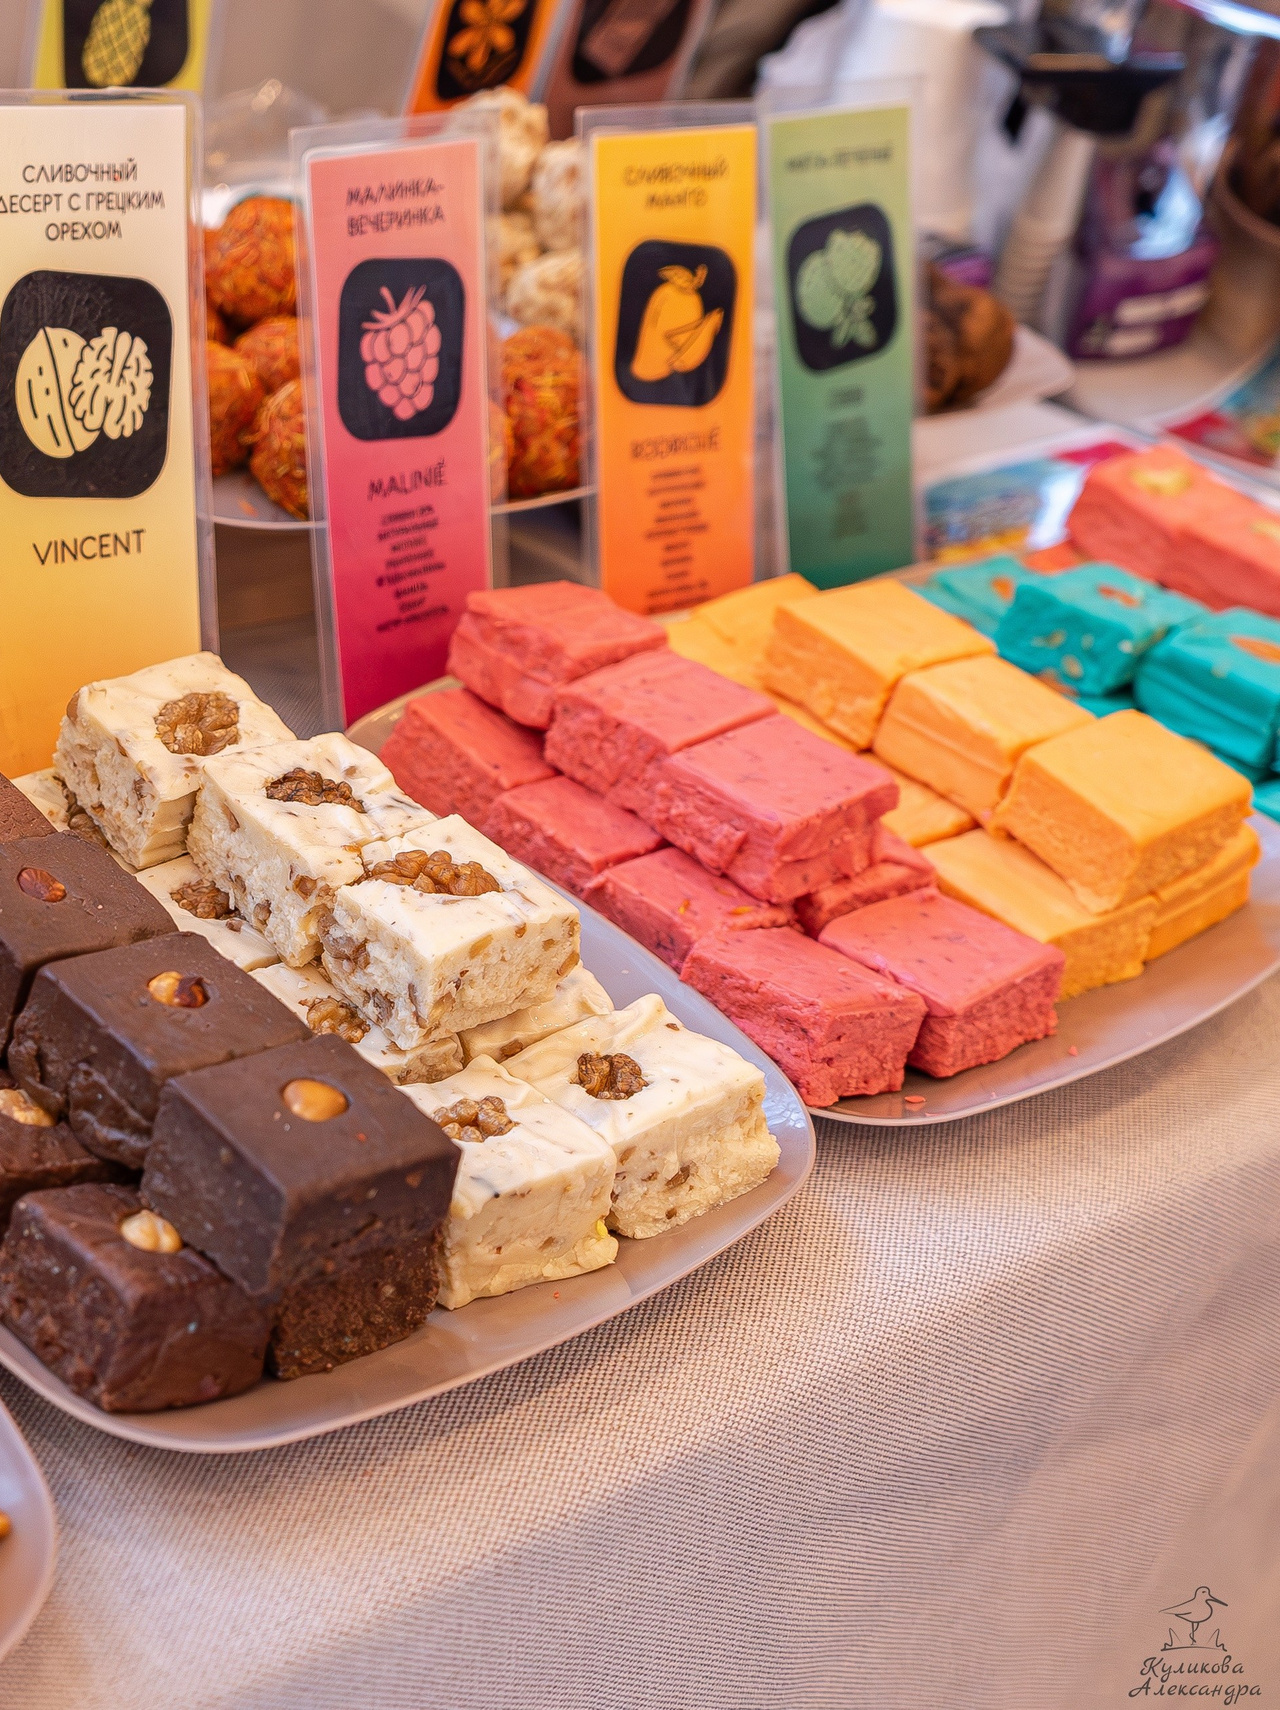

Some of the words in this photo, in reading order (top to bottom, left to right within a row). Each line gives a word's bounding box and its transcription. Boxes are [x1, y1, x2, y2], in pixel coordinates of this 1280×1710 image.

[22, 157, 138, 184] СЛИВОЧНЫЙ
[68, 193, 81, 211] С
[86, 190, 166, 214] ГРЕЦКИМ
[45, 220, 122, 241] ОРЕХОМ
[32, 528, 146, 566] VINCENT
